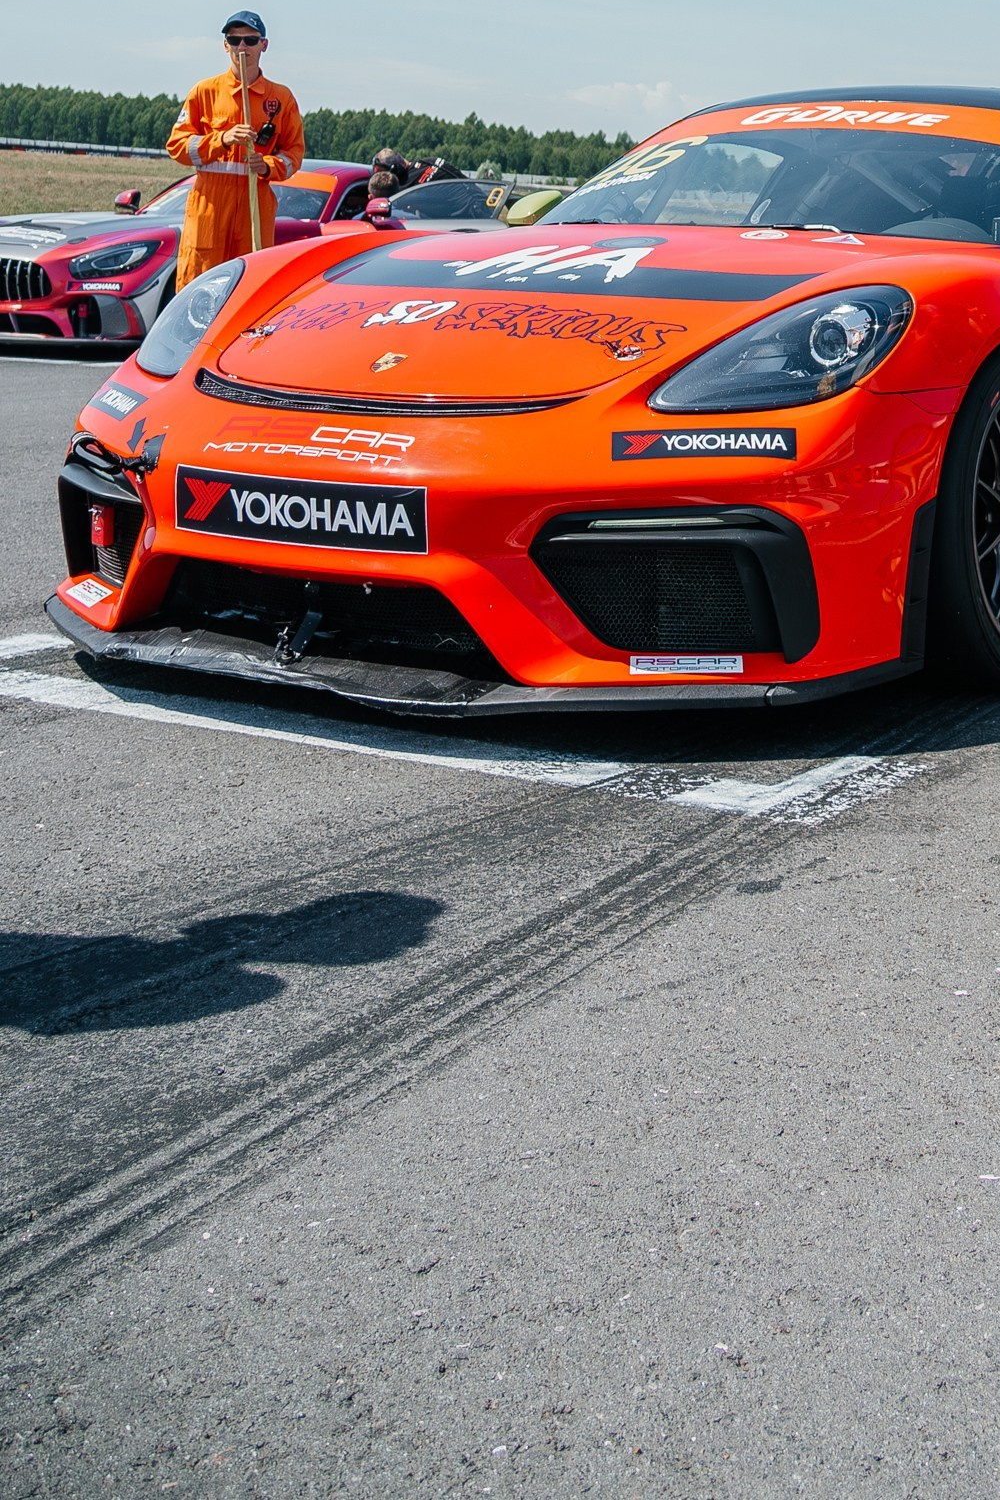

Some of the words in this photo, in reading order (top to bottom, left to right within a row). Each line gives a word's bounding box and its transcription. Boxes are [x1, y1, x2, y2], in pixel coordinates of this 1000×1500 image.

[82, 283, 121, 291] YOKOHAMA
[361, 300, 459, 328] SO
[100, 388, 138, 415] YOKOHAMA
[203, 441, 404, 467] MOTORSPORT
[662, 433, 788, 451] YOKOHAMA
[229, 488, 416, 538] YOKOHAMA
[635, 657, 738, 665] RSCAR
